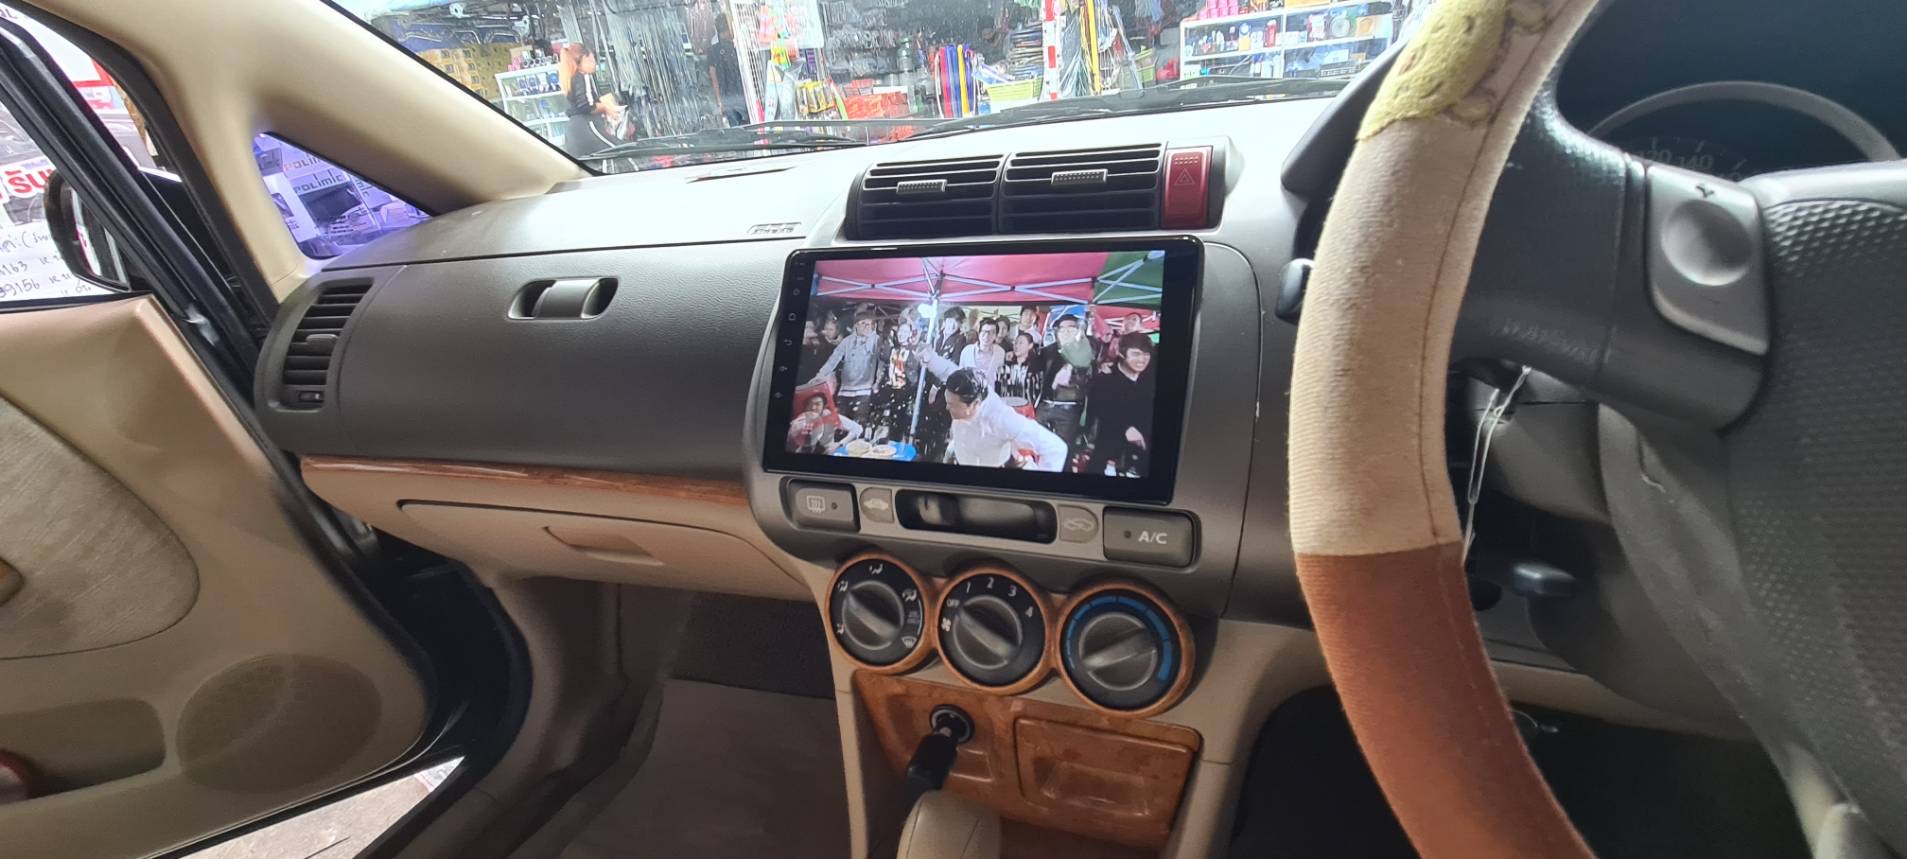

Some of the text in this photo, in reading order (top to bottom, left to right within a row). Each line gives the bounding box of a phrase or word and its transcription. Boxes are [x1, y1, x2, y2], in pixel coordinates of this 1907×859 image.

[1138, 530, 1168, 545] A/C
[946, 599, 960, 608] OFF
[987, 577, 995, 589] 2
[1008, 585, 1017, 597] 3
[1025, 606, 1034, 618] 4
